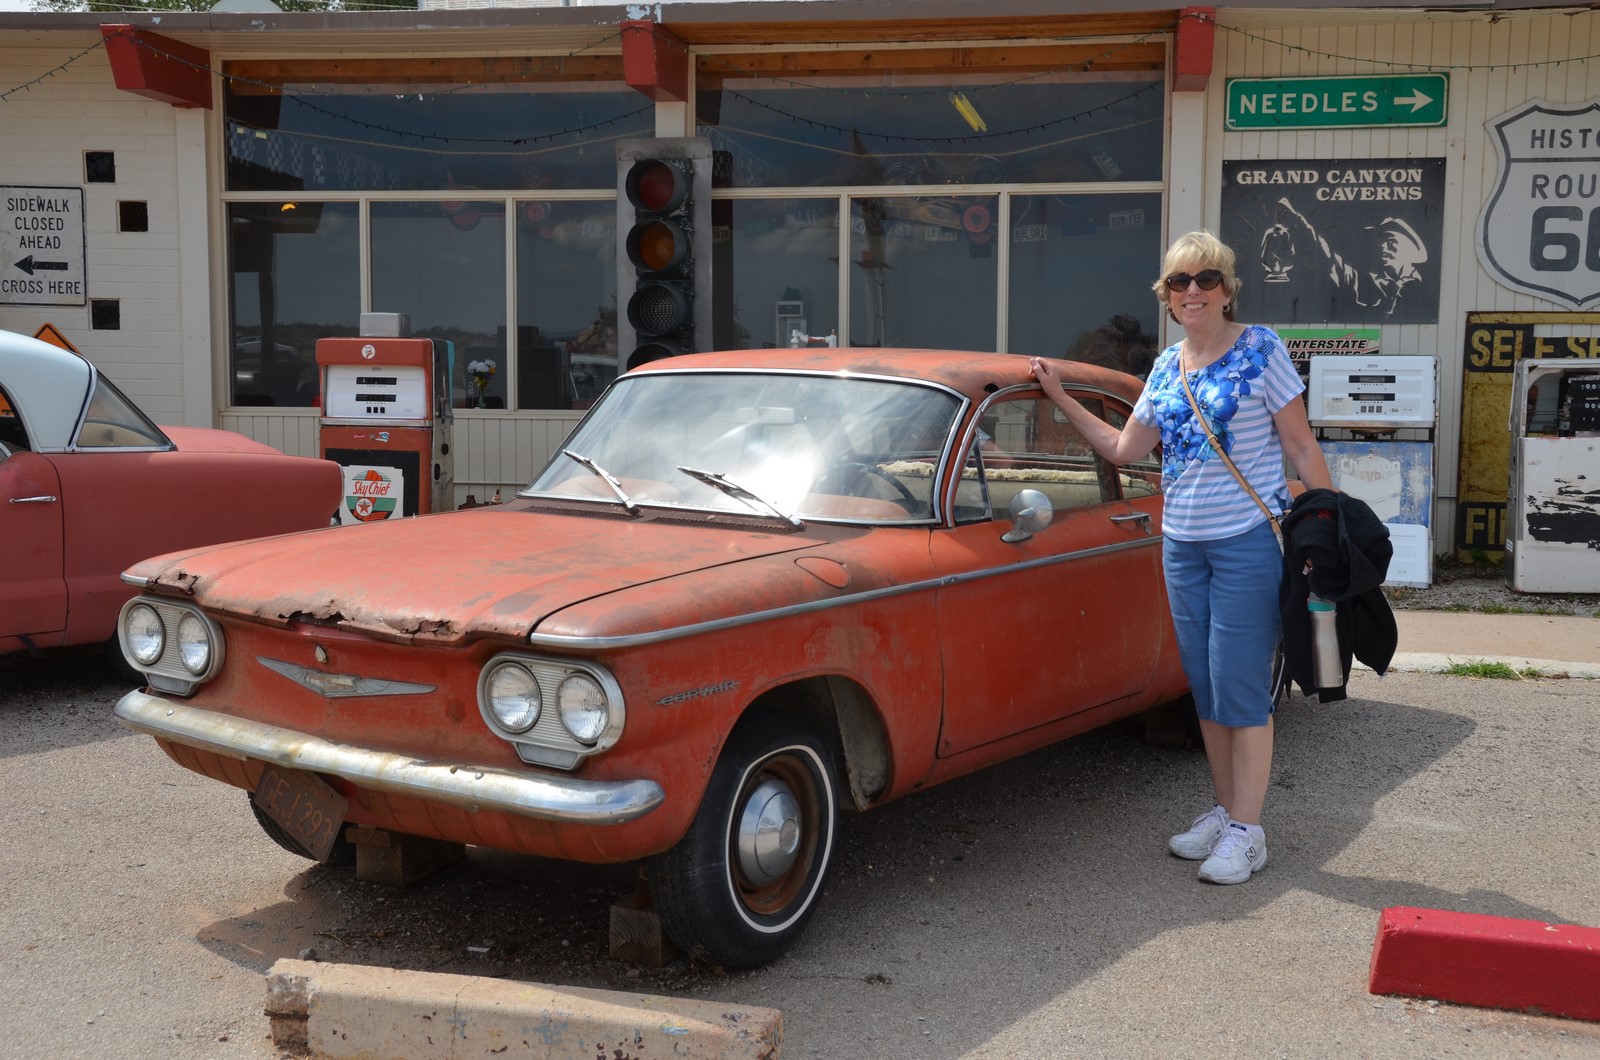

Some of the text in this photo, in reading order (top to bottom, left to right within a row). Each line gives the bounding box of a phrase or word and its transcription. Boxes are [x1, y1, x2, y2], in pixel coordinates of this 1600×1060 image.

[1240, 91, 1378, 114] NEEDLES
[1530, 128, 1600, 149] HIST
[1236, 168, 1423, 185] GRAND CANYON
[1316, 186, 1423, 201] CAVERNS
[7, 198, 70, 213] SIDEWALK
[15, 217, 64, 231] CLOSED
[19, 235, 61, 249] AHEAD
[2, 279, 81, 295] CROSS HERE
[1287, 339, 1367, 349] INTERSTATE
[352, 481, 391, 497] Sky Chief
